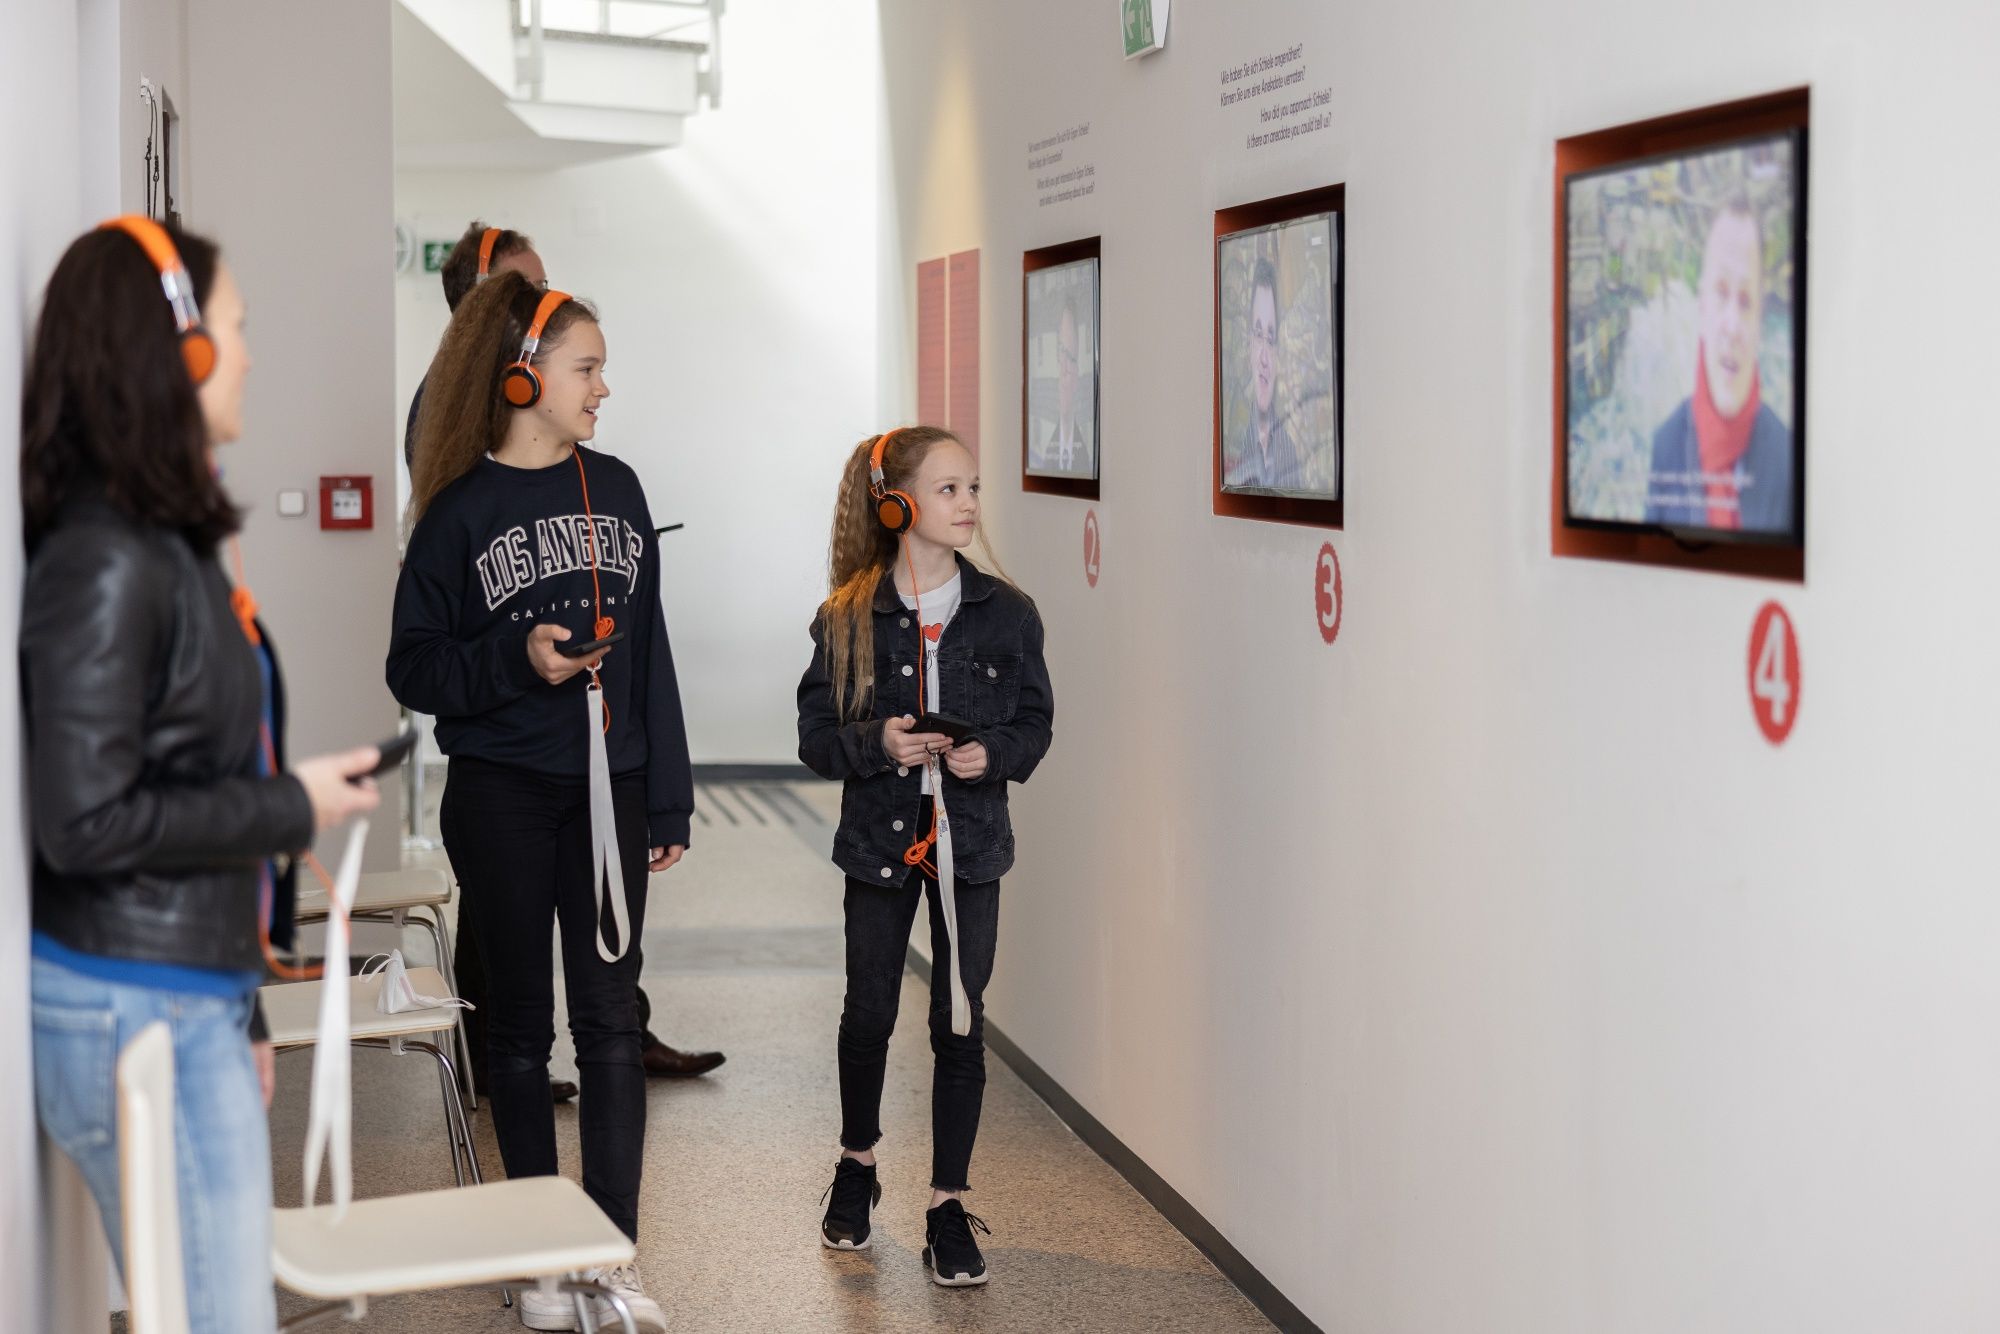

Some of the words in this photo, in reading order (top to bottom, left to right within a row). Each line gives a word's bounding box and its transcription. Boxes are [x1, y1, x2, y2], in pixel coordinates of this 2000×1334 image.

[1220, 92, 1237, 108] Können
[1243, 89, 1251, 100] uns
[1251, 83, 1261, 97] eine
[1261, 75, 1284, 94] Anekdote
[1284, 65, 1306, 86] verraten?
[1221, 70, 1230, 86] Wie
[1230, 66, 1243, 82] haben
[1250, 61, 1259, 76] sich
[1259, 54, 1274, 73] Schiele
[1250, 133, 1263, 148] there
[1262, 133, 1270, 146] an
[1269, 124, 1291, 143] anecdote
[1290, 128, 1301, 141] you
[1300, 118, 1314, 136] could
[1313, 113, 1323, 131] tell
[1323, 111, 1332, 129] us?
[1260, 108, 1272, 124] How
[1272, 104, 1280, 120] did
[1280, 108, 1289, 121] you
[1289, 95, 1312, 117] approach
[1312, 87, 1332, 108] Schiele?
[476, 526, 537, 612] LOS
[535, 514, 644, 596] ANGELS
[1087, 517, 1098, 577] 2
[1321, 552, 1338, 629] 3
[1754, 612, 1792, 725] 4
